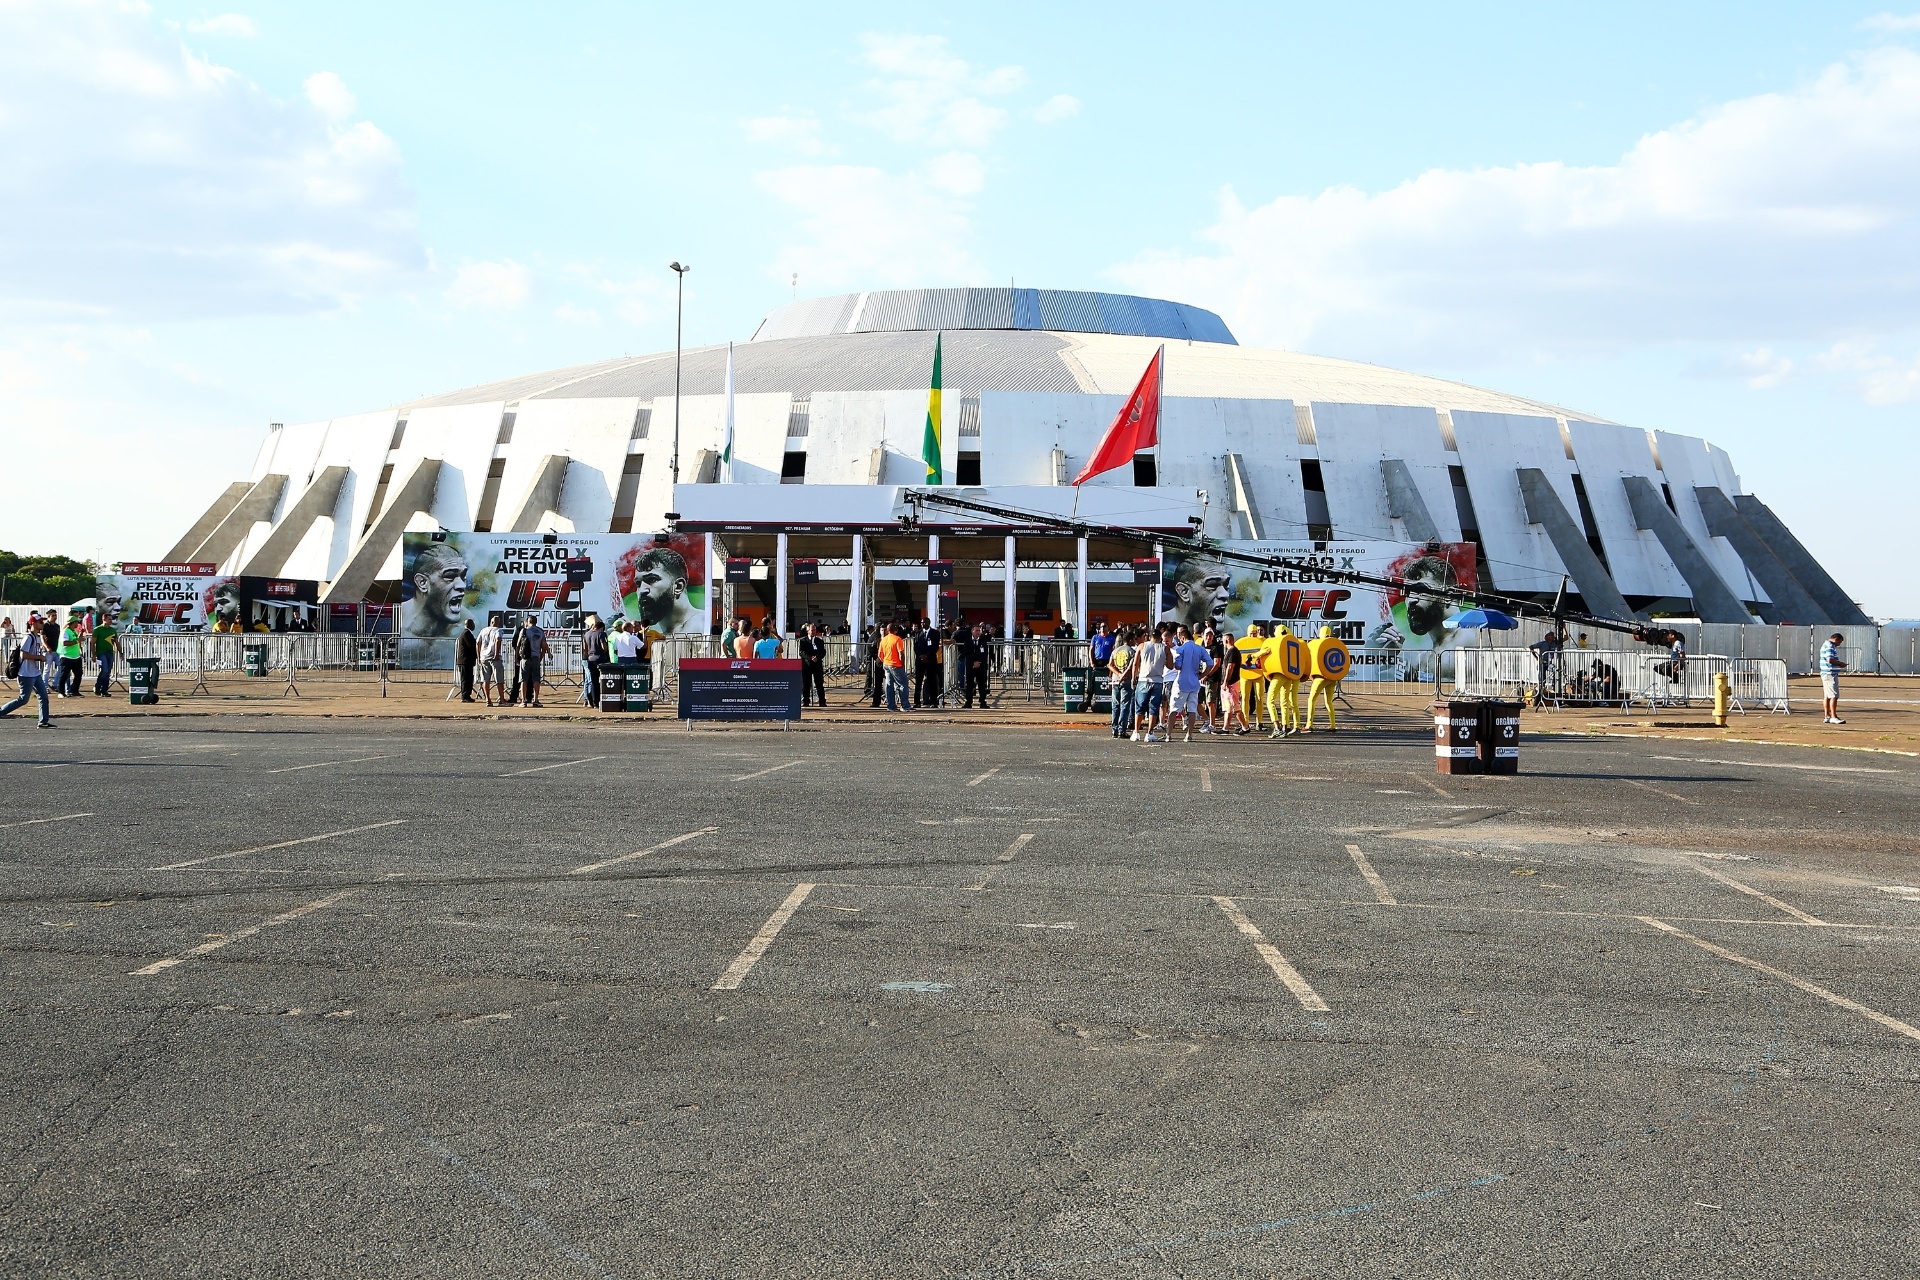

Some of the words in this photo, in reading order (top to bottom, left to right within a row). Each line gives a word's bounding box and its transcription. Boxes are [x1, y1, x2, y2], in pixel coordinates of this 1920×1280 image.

[503, 545, 569, 560] PEZÃO
[146, 565, 192, 573] BILHETERIA
[1340, 556, 1354, 569] X
[136, 580, 181, 591] PEZÃO
[185, 582, 194, 591] X
[130, 591, 198, 601] ARLOVSKI
[506, 580, 585, 610] UFC
[1271, 589, 1352, 620] UFC
[138, 603, 194, 624] UFC
[1451, 717, 1478, 726] ORGÂNICO
